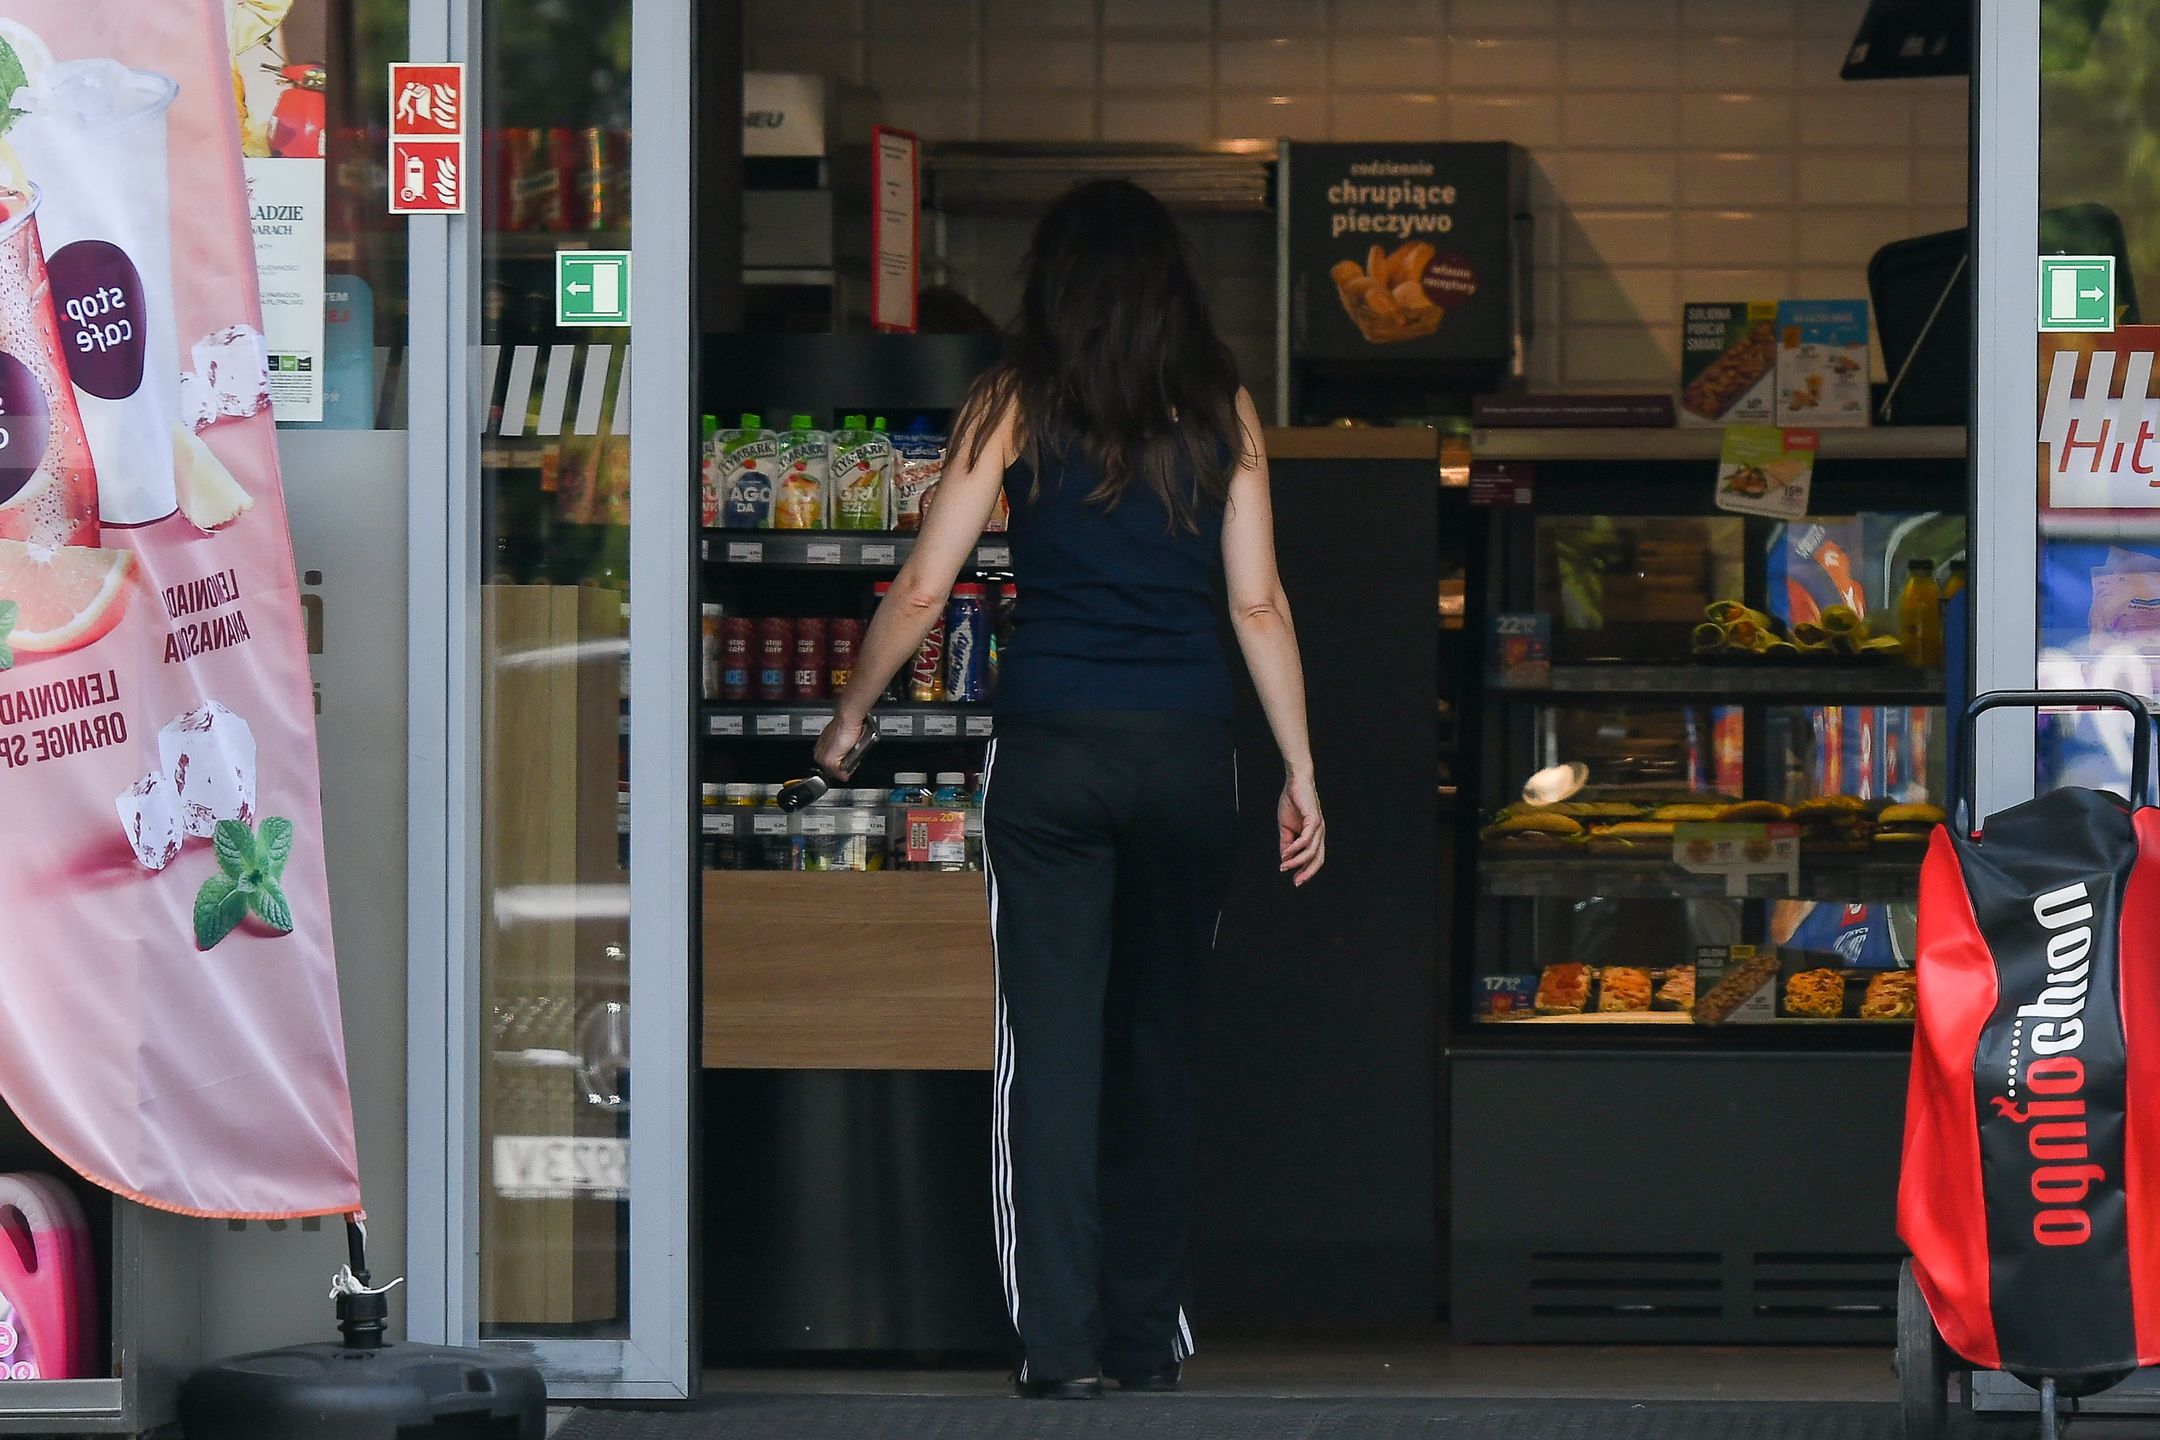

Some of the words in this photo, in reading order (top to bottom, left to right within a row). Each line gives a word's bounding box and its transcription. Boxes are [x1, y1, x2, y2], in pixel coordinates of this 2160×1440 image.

[1328, 179, 1457, 209] chrupiące
[1332, 208, 1453, 238] pieczywo
[721, 442, 773, 472] TYMBARK
[2016, 882, 2106, 1246] ogniochron
